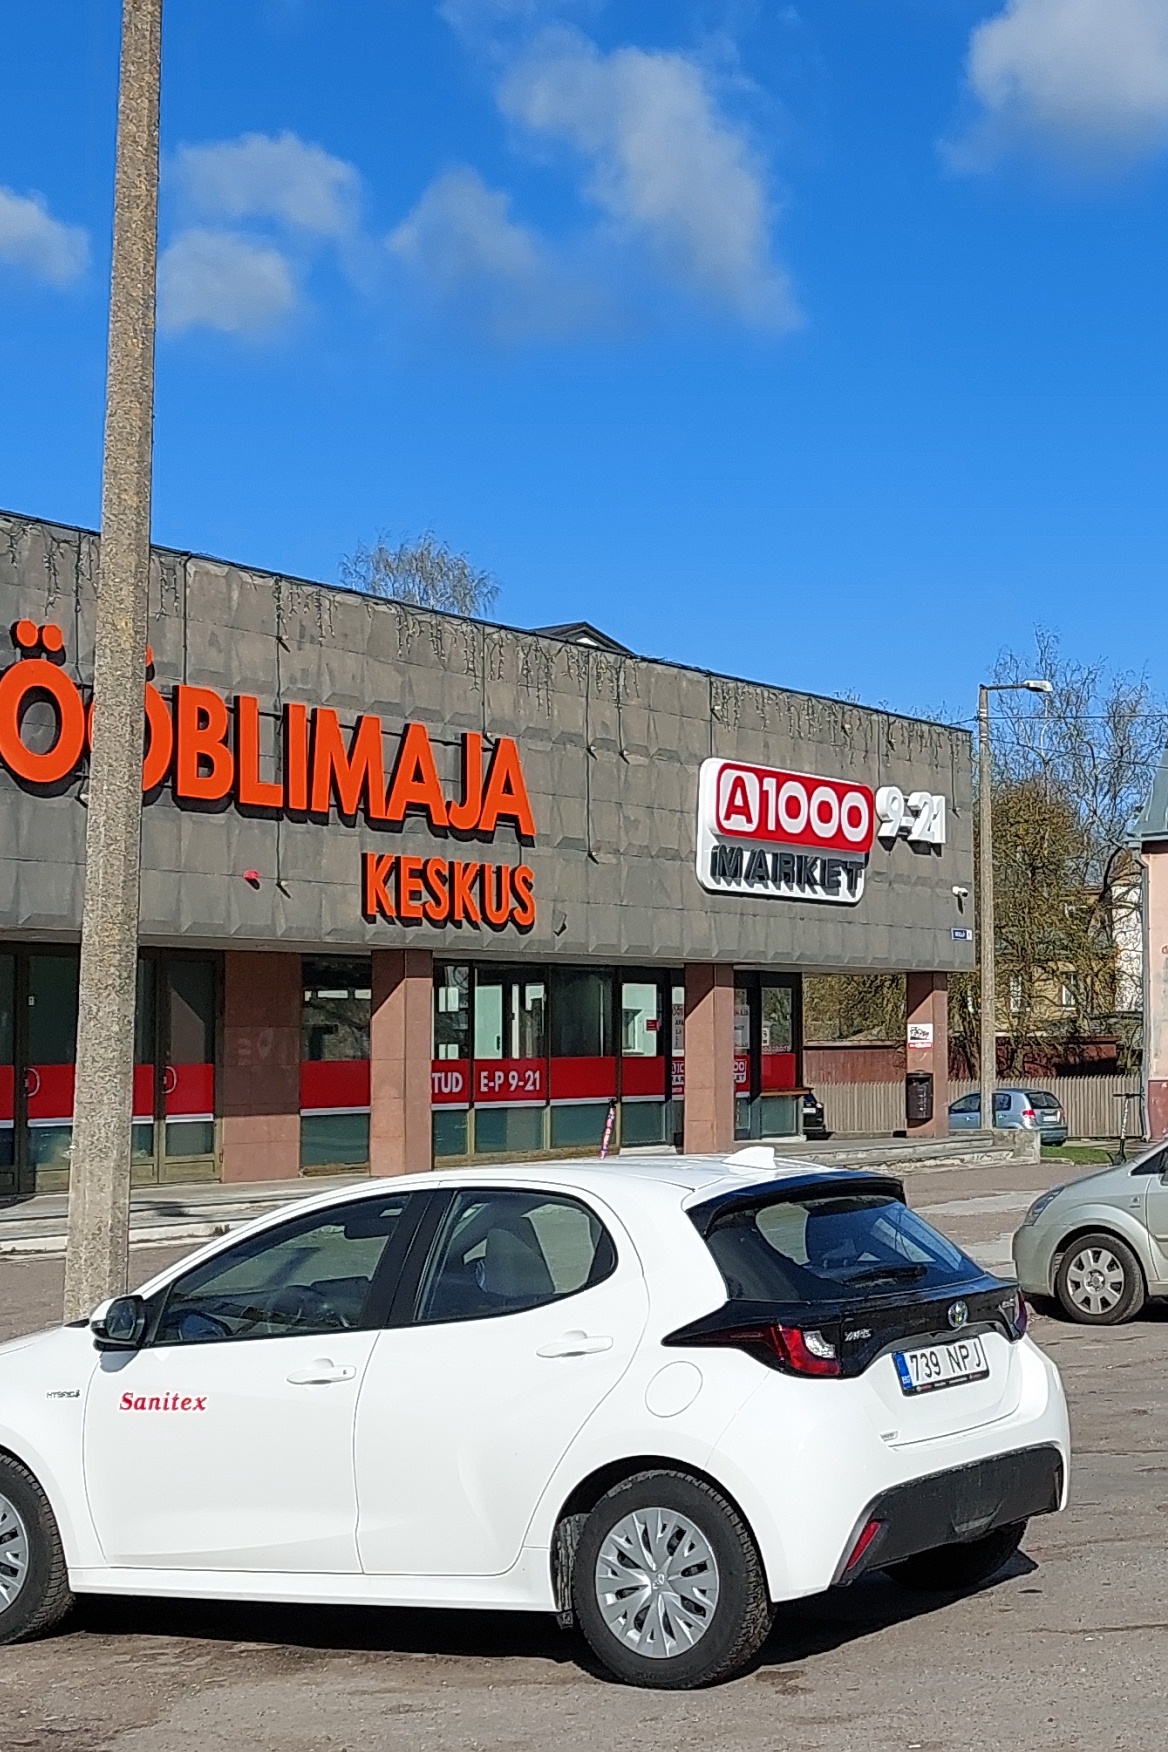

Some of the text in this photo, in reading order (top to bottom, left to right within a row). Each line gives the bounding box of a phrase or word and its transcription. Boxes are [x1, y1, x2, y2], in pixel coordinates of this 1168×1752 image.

[719, 769, 869, 843] A1000
[876, 786, 946, 844] 9-21
[364, 852, 536, 927] KESKUS
[711, 845, 864, 891] MARKET
[480, 1071, 504, 1092] E-P
[508, 1070, 540, 1092] 9-21
[910, 1351, 941, 1382] 739
[946, 1341, 982, 1374] NPJ
[119, 1392, 208, 1411] Sanitex
